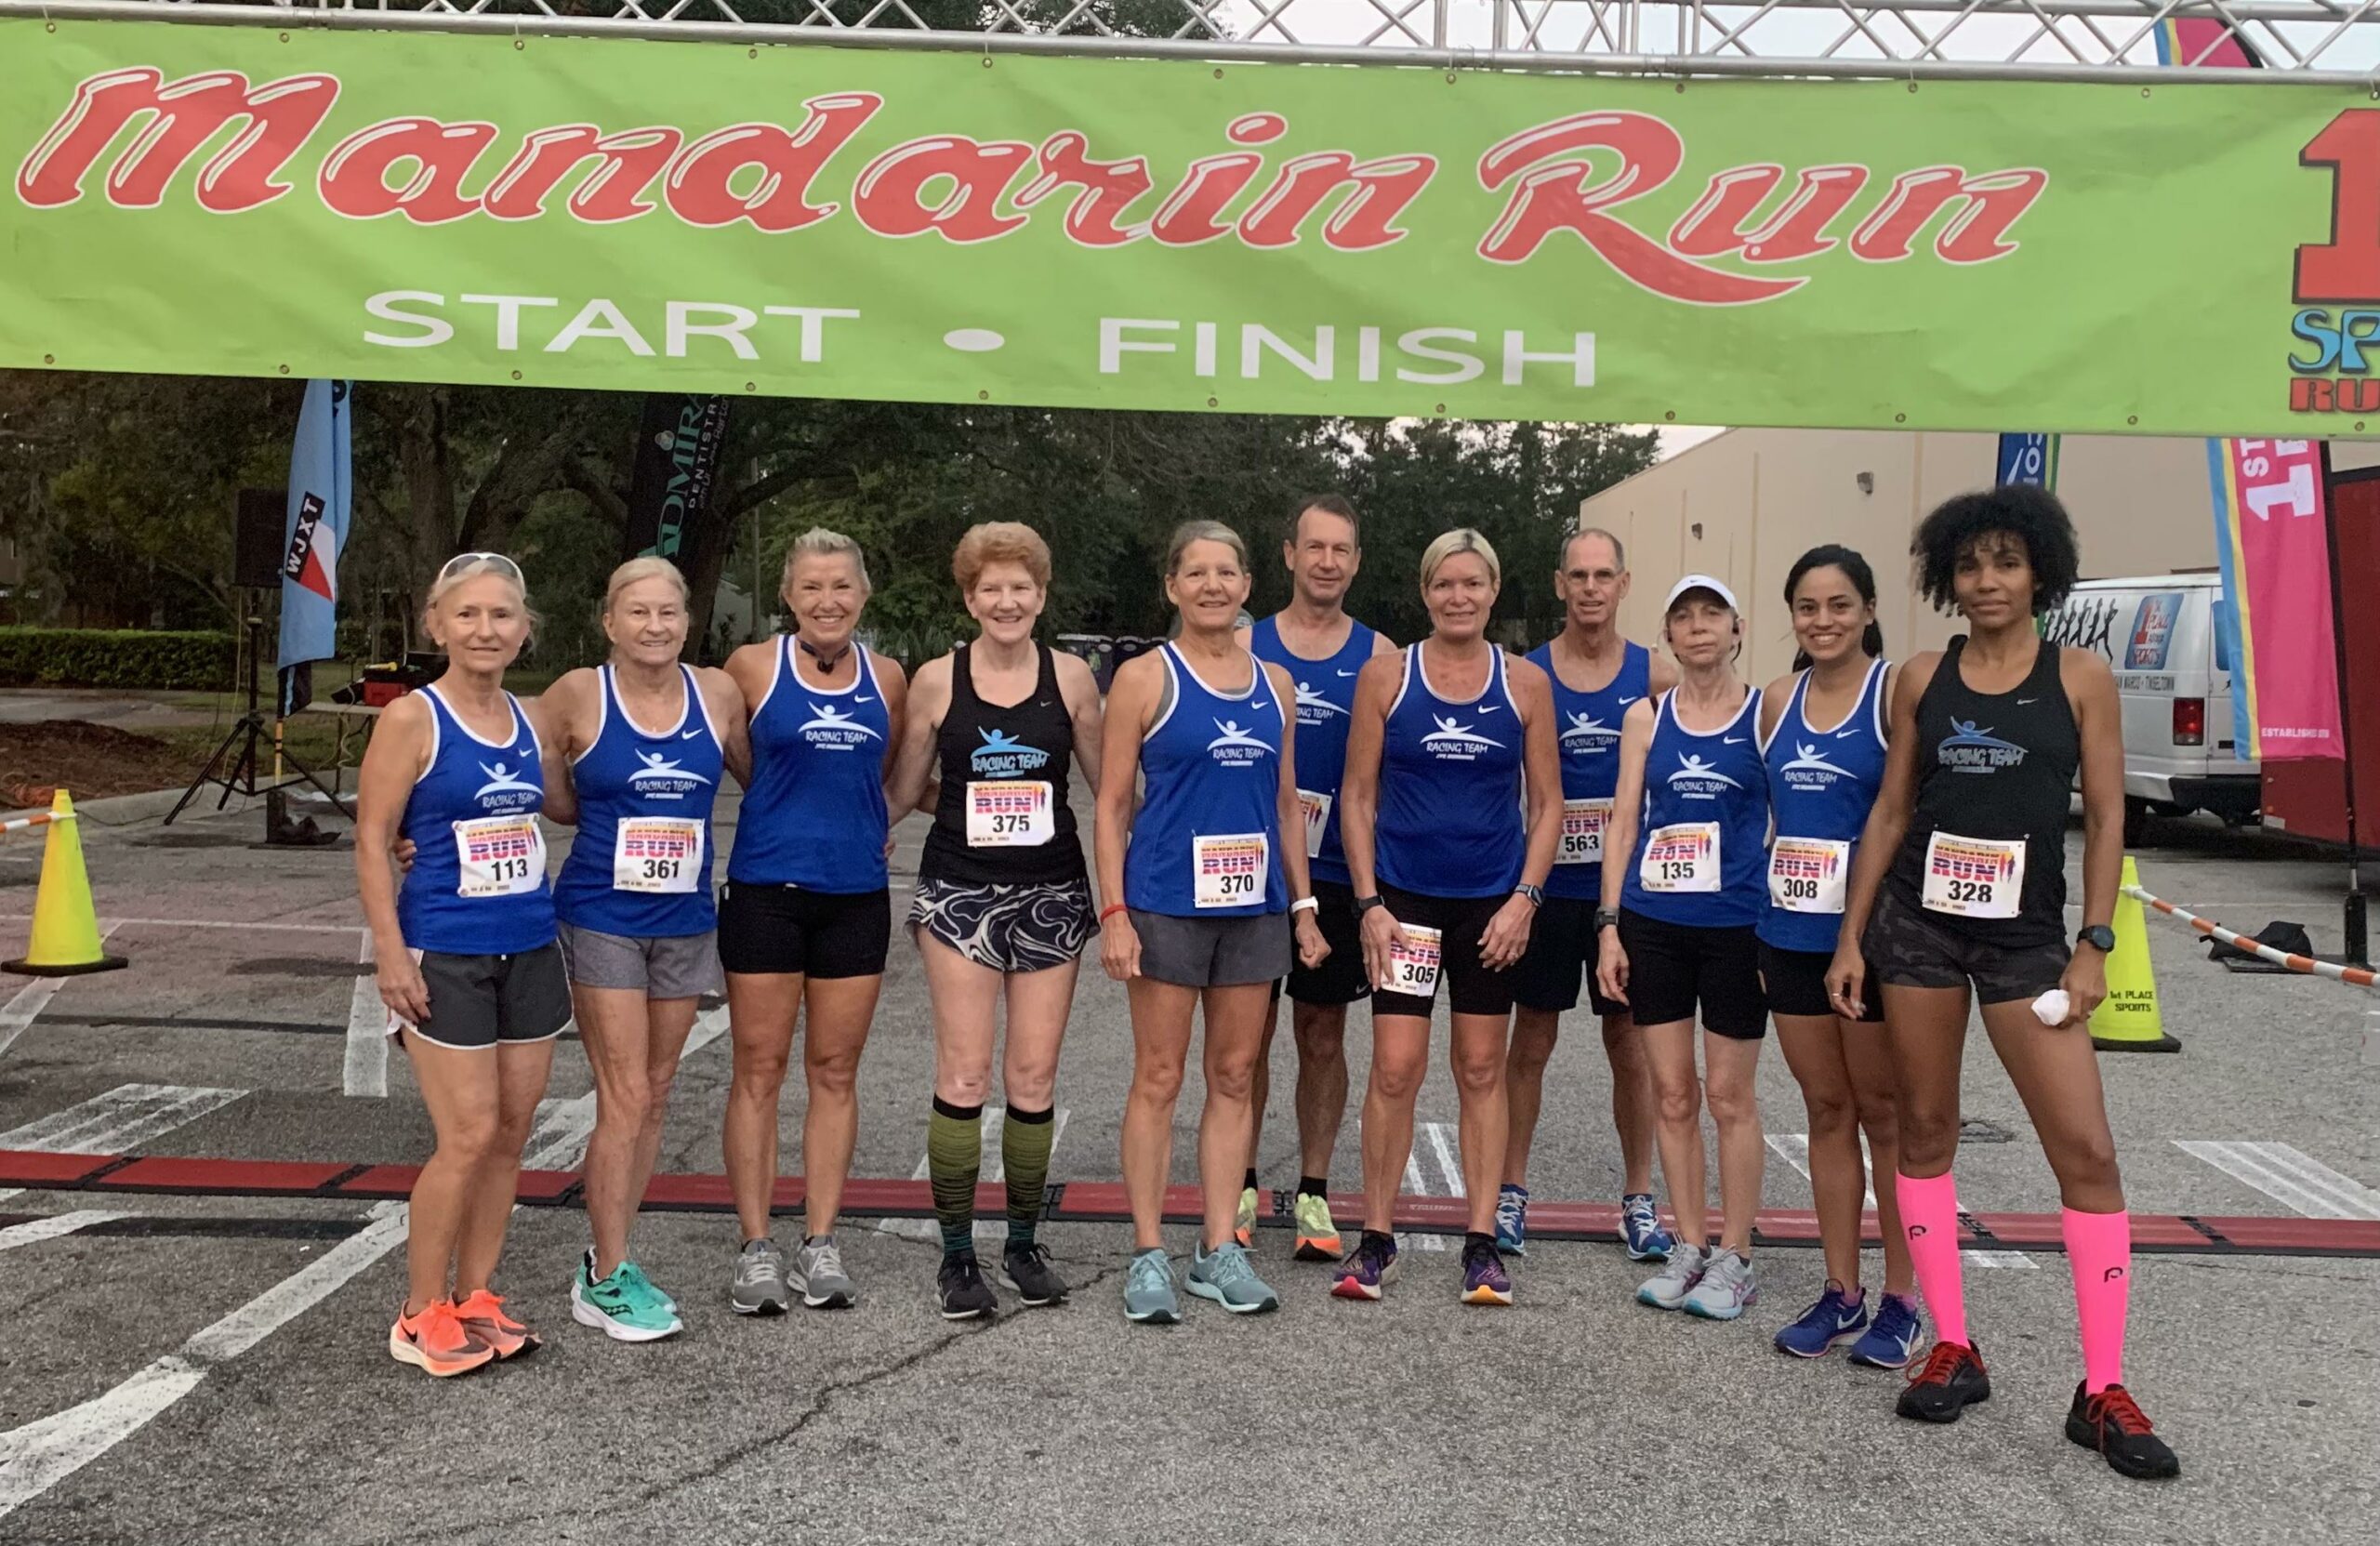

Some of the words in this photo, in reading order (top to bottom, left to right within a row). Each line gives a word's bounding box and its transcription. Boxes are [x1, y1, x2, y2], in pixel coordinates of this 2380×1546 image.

[16, 65, 1438, 251] Mandarin
[1476, 109, 2049, 306] Run
[364, 289, 861, 363] START
[1099, 316, 1596, 388] FINISH
[286, 497, 318, 573] WJXT
[1313, 707, 1334, 720] TEAM
[805, 731, 841, 743] RACING
[843, 732, 867, 744] TEAM
[1595, 735, 1618, 747] TEAM
[1212, 747, 1243, 760] RACING
[1244, 747, 1264, 759] TEAM
[1426, 742, 1461, 754] RACING
[1463, 742, 1488, 754] TEAM
[1938, 748, 1987, 767] RACING
[1988, 747, 2024, 766] TEAM
[972, 756, 1016, 773] RACING
[1017, 754, 1048, 770] TEAM
[635, 780, 671, 792] RACING
[672, 780, 697, 791] TEAM
[1673, 781, 1704, 792] RACING
[1705, 780, 1727, 792] TEAM
[1784, 771, 1814, 784] RACING
[1816, 772, 1837, 784] TEAM
[482, 793, 516, 809] RACING
[517, 792, 536, 805] TEAM
[975, 798, 1031, 814] RUN
[992, 815, 1030, 833] 375
[1563, 819, 1599, 835] UN
[469, 839, 528, 862] RUN
[625, 840, 684, 858] RUN
[1565, 835, 1599, 852] 563
[1648, 844, 1696, 861] RUN
[491, 859, 528, 881] 113
[643, 859, 680, 879] 361
[1202, 856, 1254, 875] RUN
[1661, 862, 1695, 879] 135
[1773, 859, 1820, 879] RUN
[1932, 856, 1996, 882] RUN
[1221, 874, 1254, 894] 370
[1783, 879, 1818, 899] 308
[1948, 879, 1992, 903] 328
[1402, 963, 1435, 984] 305
[2124, 990, 2153, 999] PLACE
[2115, 1003, 2151, 1012] SPORTS
